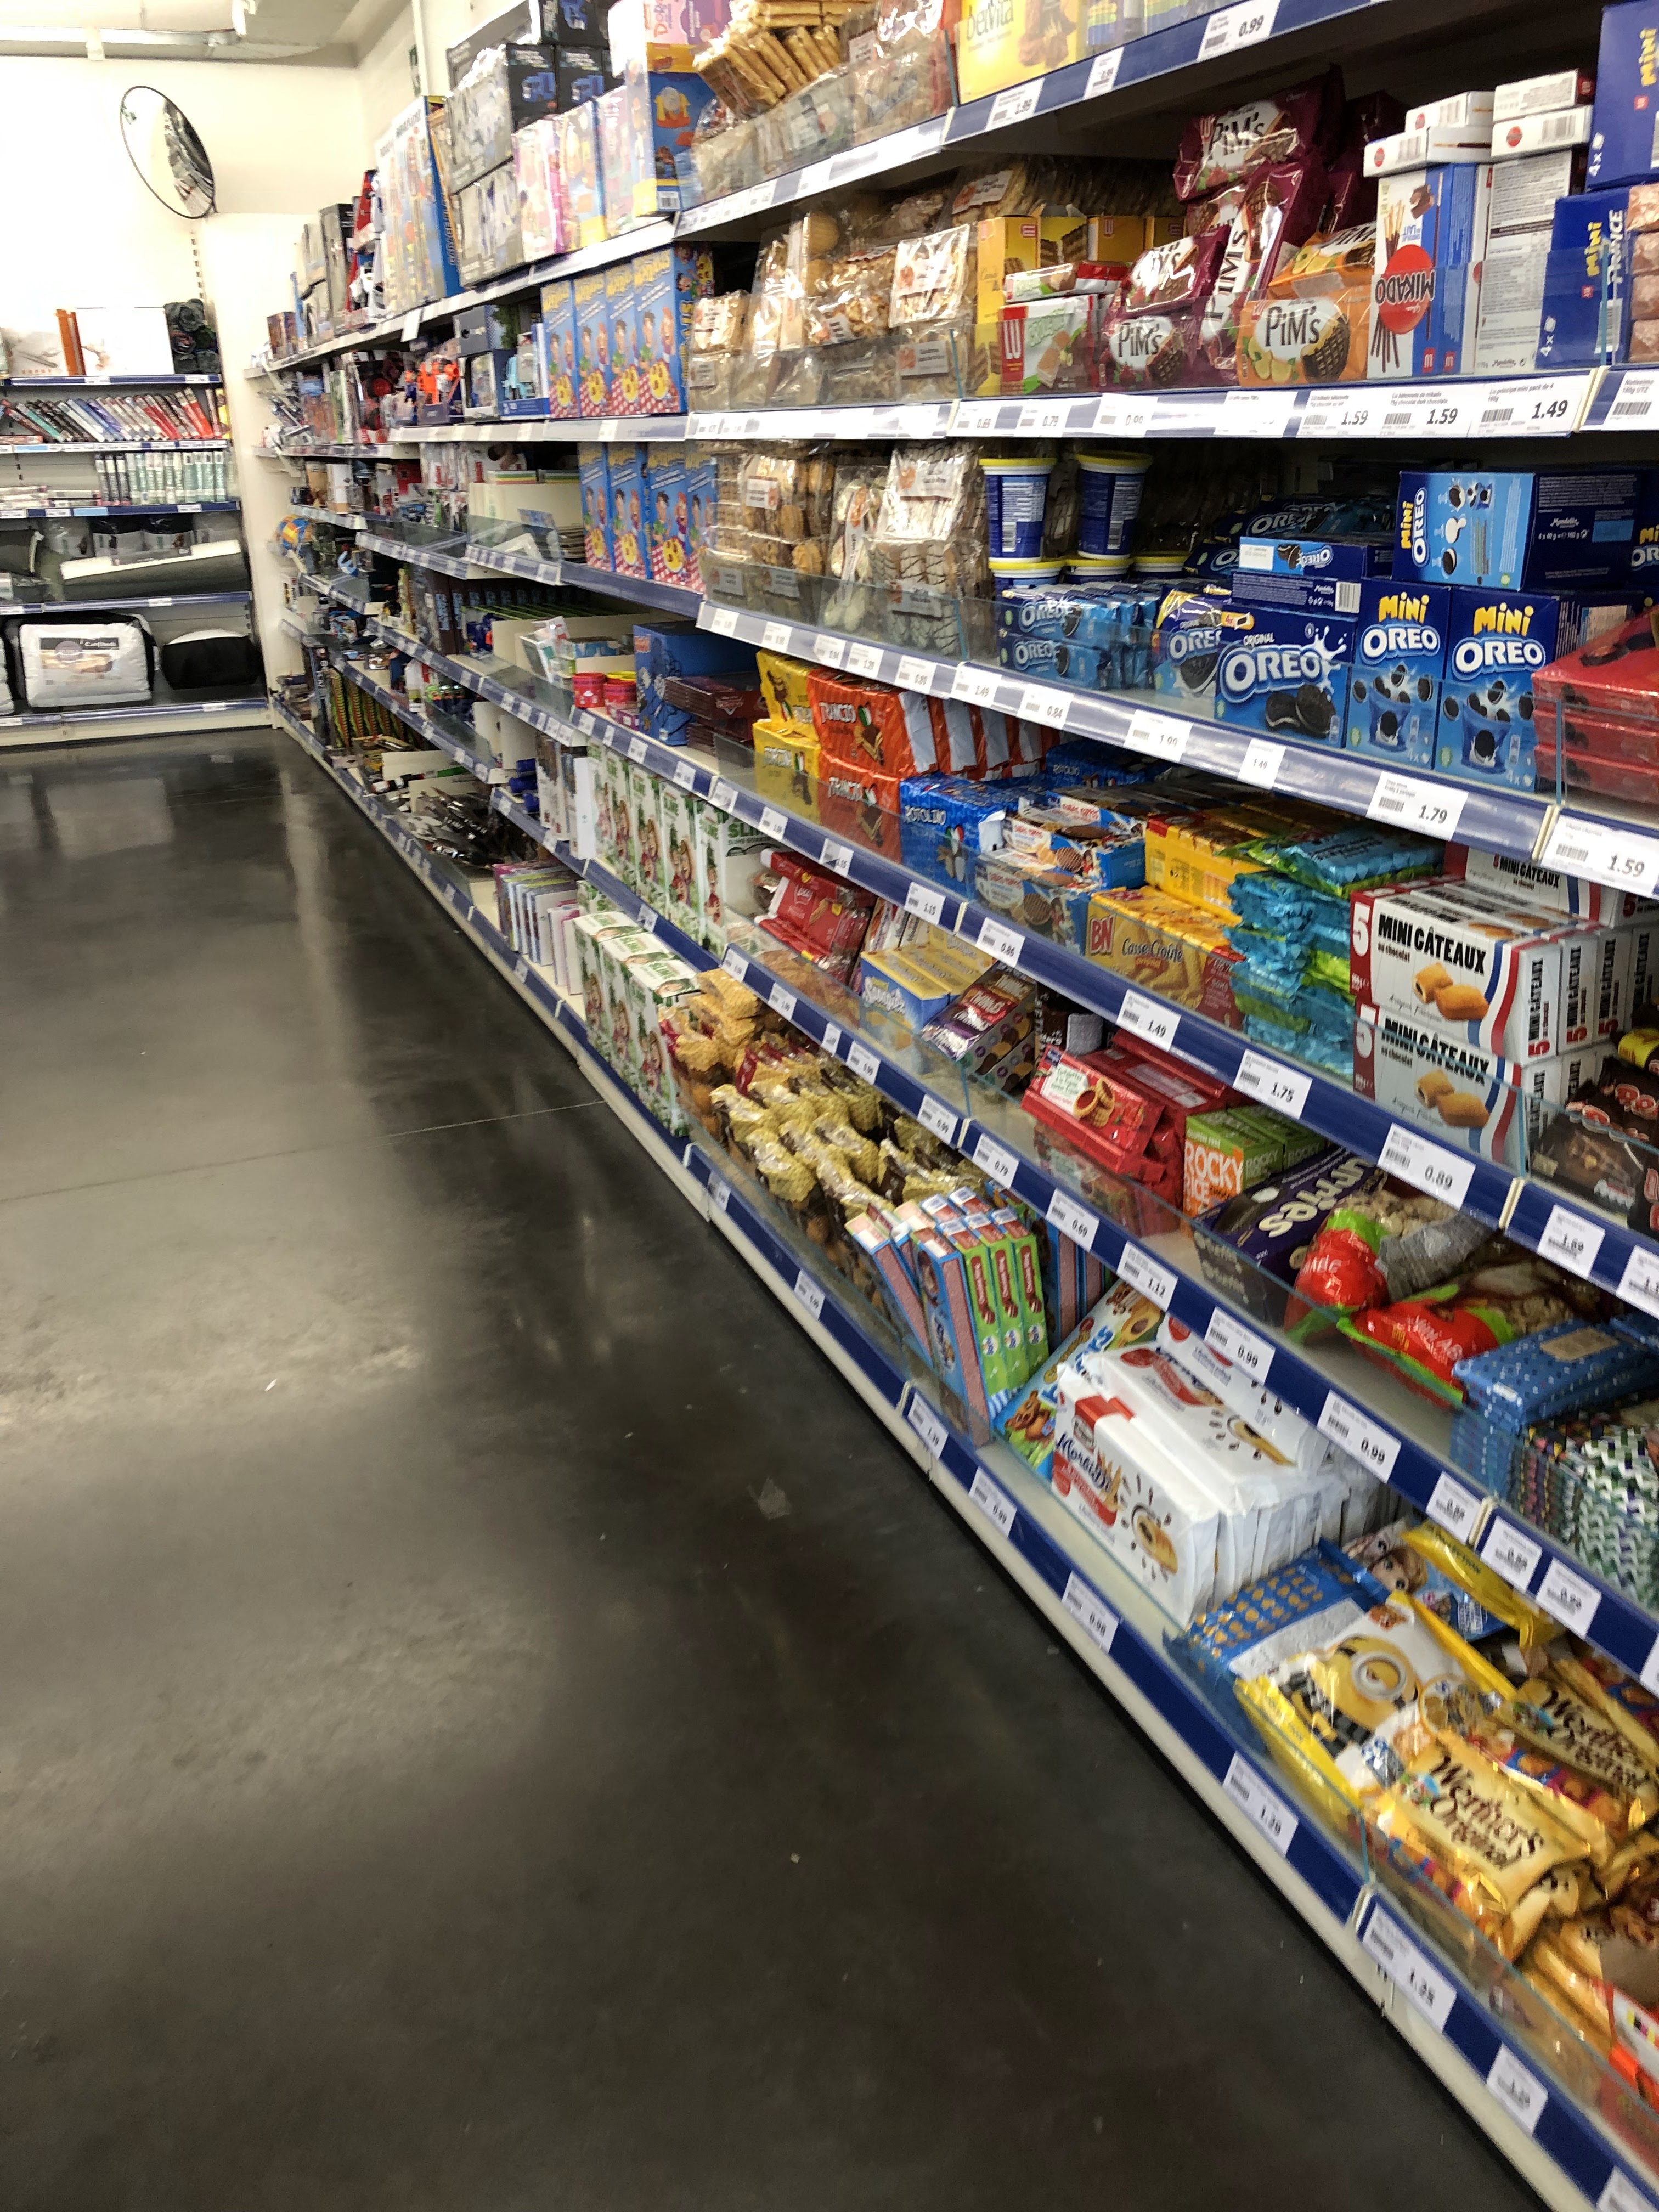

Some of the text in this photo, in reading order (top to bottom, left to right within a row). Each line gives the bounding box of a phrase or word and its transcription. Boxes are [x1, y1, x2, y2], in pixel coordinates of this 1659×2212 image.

[1238, 15, 1265, 37] 0.99
[1375, 269, 1436, 306] MIKADO
[1266, 304, 1320, 347] PiM's
[1341, 410, 1368, 426] 1.59
[1426, 408, 1458, 425] 1.59
[1531, 400, 1568, 419] 1.49
[1413, 489, 1426, 564] OREO
[1243, 633, 1276, 646] ORIGINAL
[1363, 628, 1437, 658] OREO
[1455, 641, 1543, 674] OREO
[1225, 650, 1322, 692] OREO
[1047, 706, 1063, 720] 0.84
[1418, 804, 1448, 824] 1.79
[1607, 854, 1645, 878] 1.59
[1090, 914, 1116, 956] BN
[1353, 901, 1370, 957] 5
[1378, 912, 1413, 947] MINI
[1385, 945, 1410, 963] chocolat
[1147, 1020, 1167, 1039] 1.49
[1528, 1040, 1550, 1058] 5
[994, 1159, 1009, 1177] 0.79
[1184, 1139, 1244, 1195] ROCKY
[1425, 1164, 1453, 1191] 0.89
[1238, 1345, 1259, 1368] 0.99
[1429, 1752, 1544, 1859] Werther's
